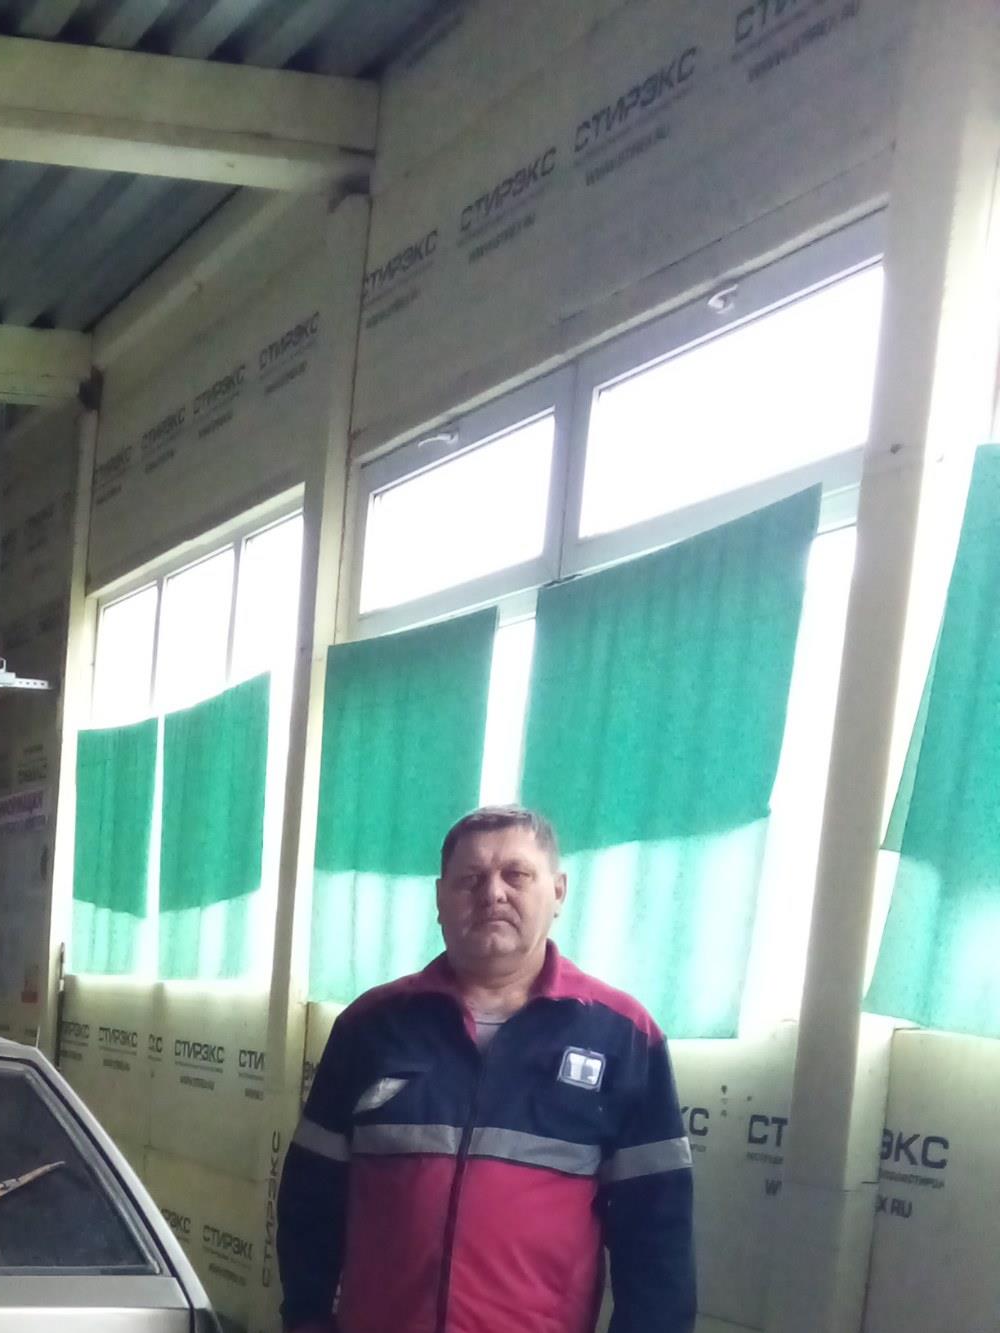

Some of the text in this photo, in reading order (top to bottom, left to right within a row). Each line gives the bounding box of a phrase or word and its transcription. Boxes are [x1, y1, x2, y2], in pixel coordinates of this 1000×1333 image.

[573, 46, 698, 153] СТИРЭКС
[459, 146, 557, 232] СТИРЭКС
[174, 1039, 225, 1064] СТИРЭКС
[747, 1114, 789, 1148] СТ
